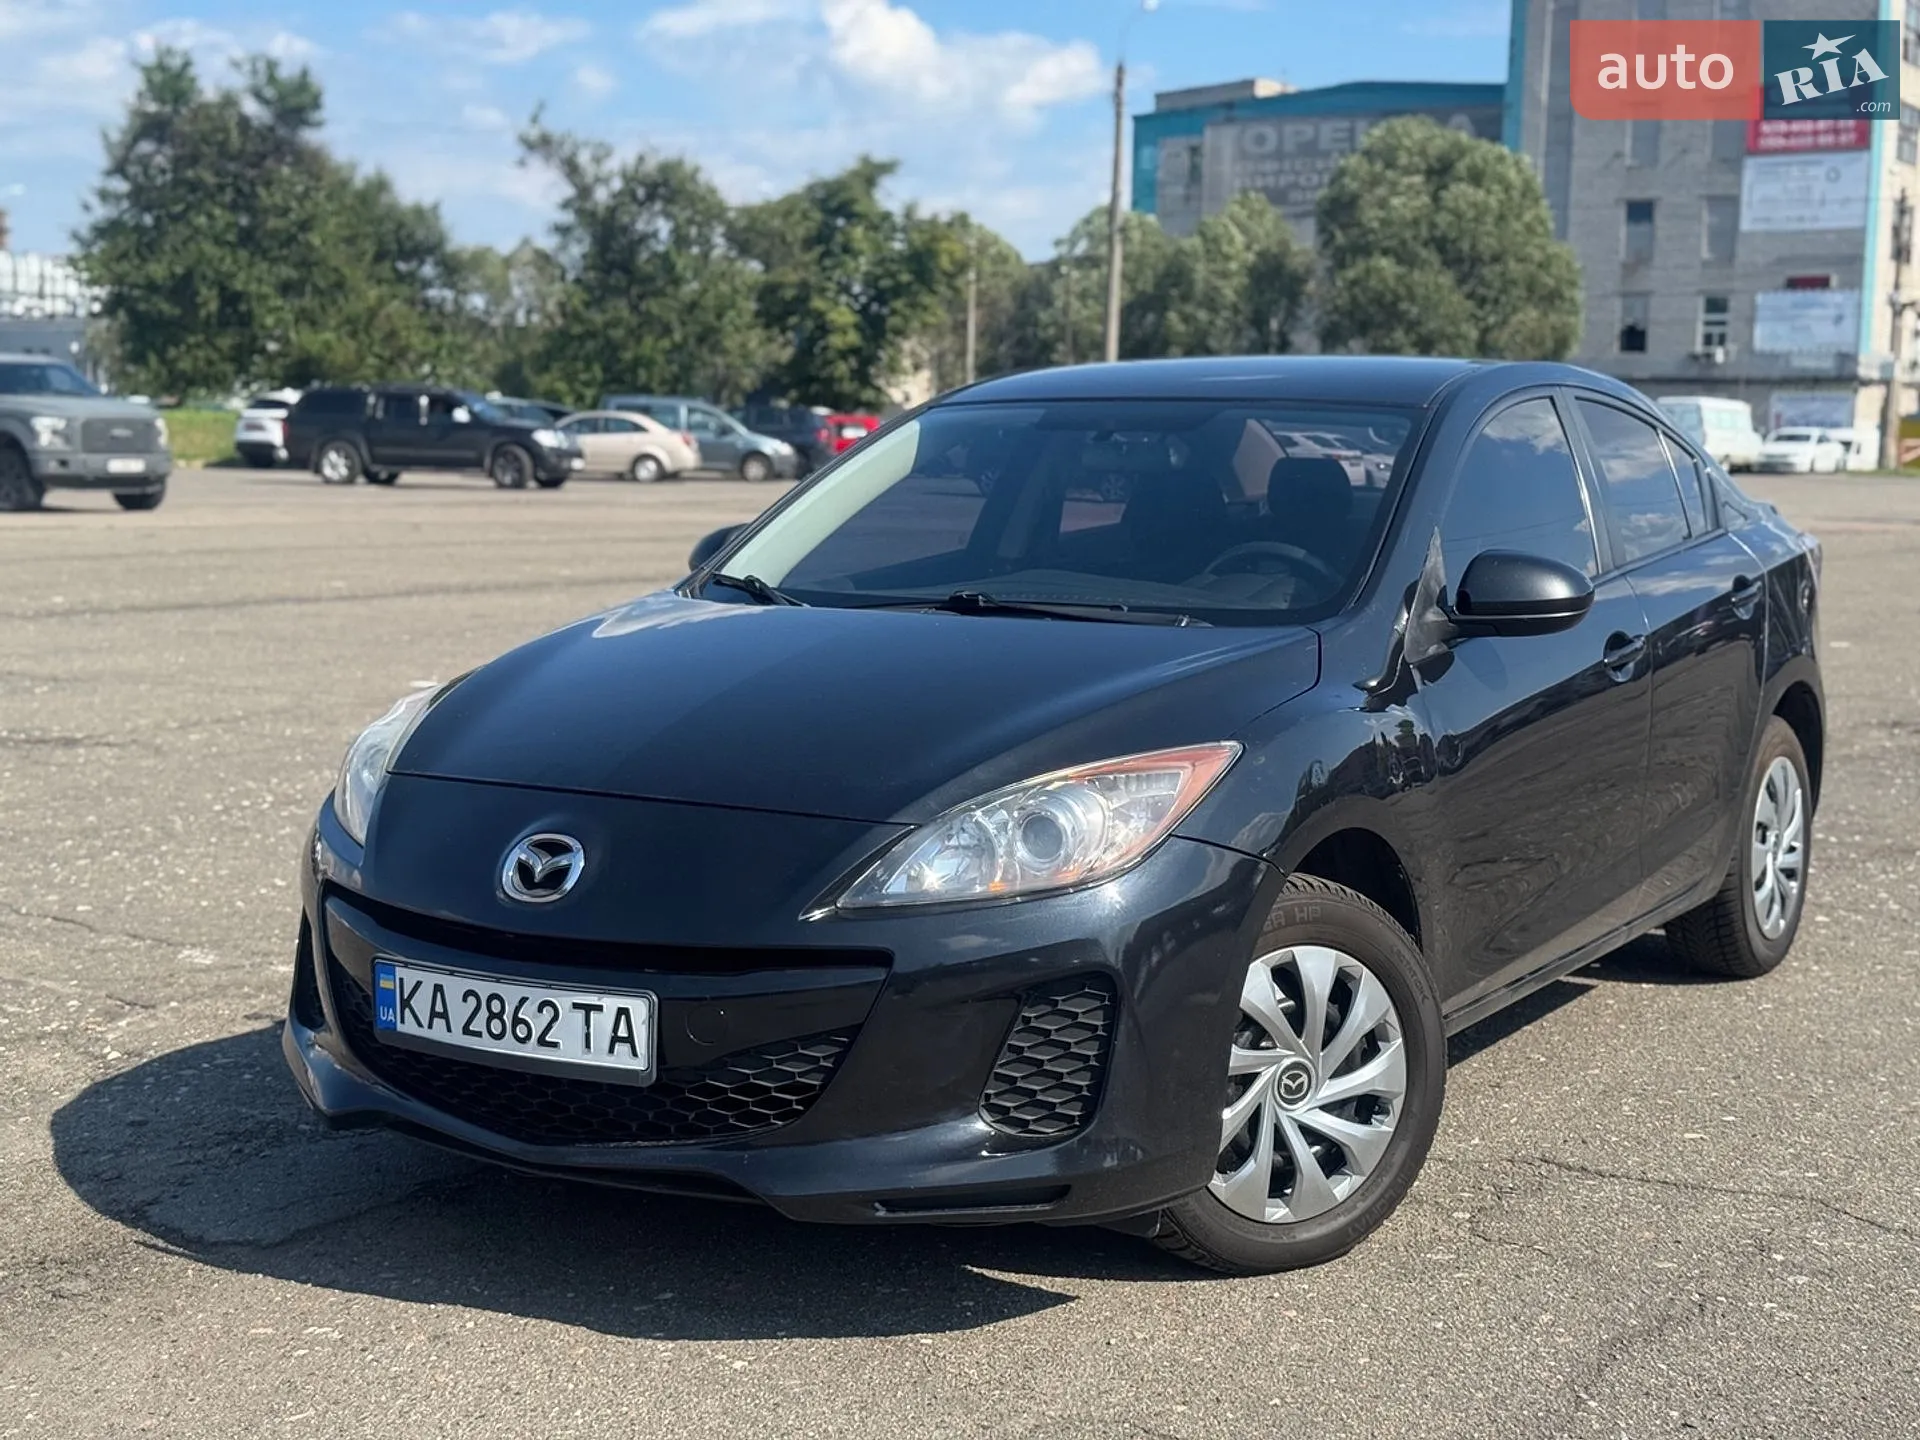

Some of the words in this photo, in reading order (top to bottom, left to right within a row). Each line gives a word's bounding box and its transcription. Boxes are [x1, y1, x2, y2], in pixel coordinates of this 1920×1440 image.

[379, 1005, 396, 1024] UA
[398, 977, 452, 1033] KA
[461, 988, 562, 1049] 2862
[572, 1001, 640, 1058] TA
